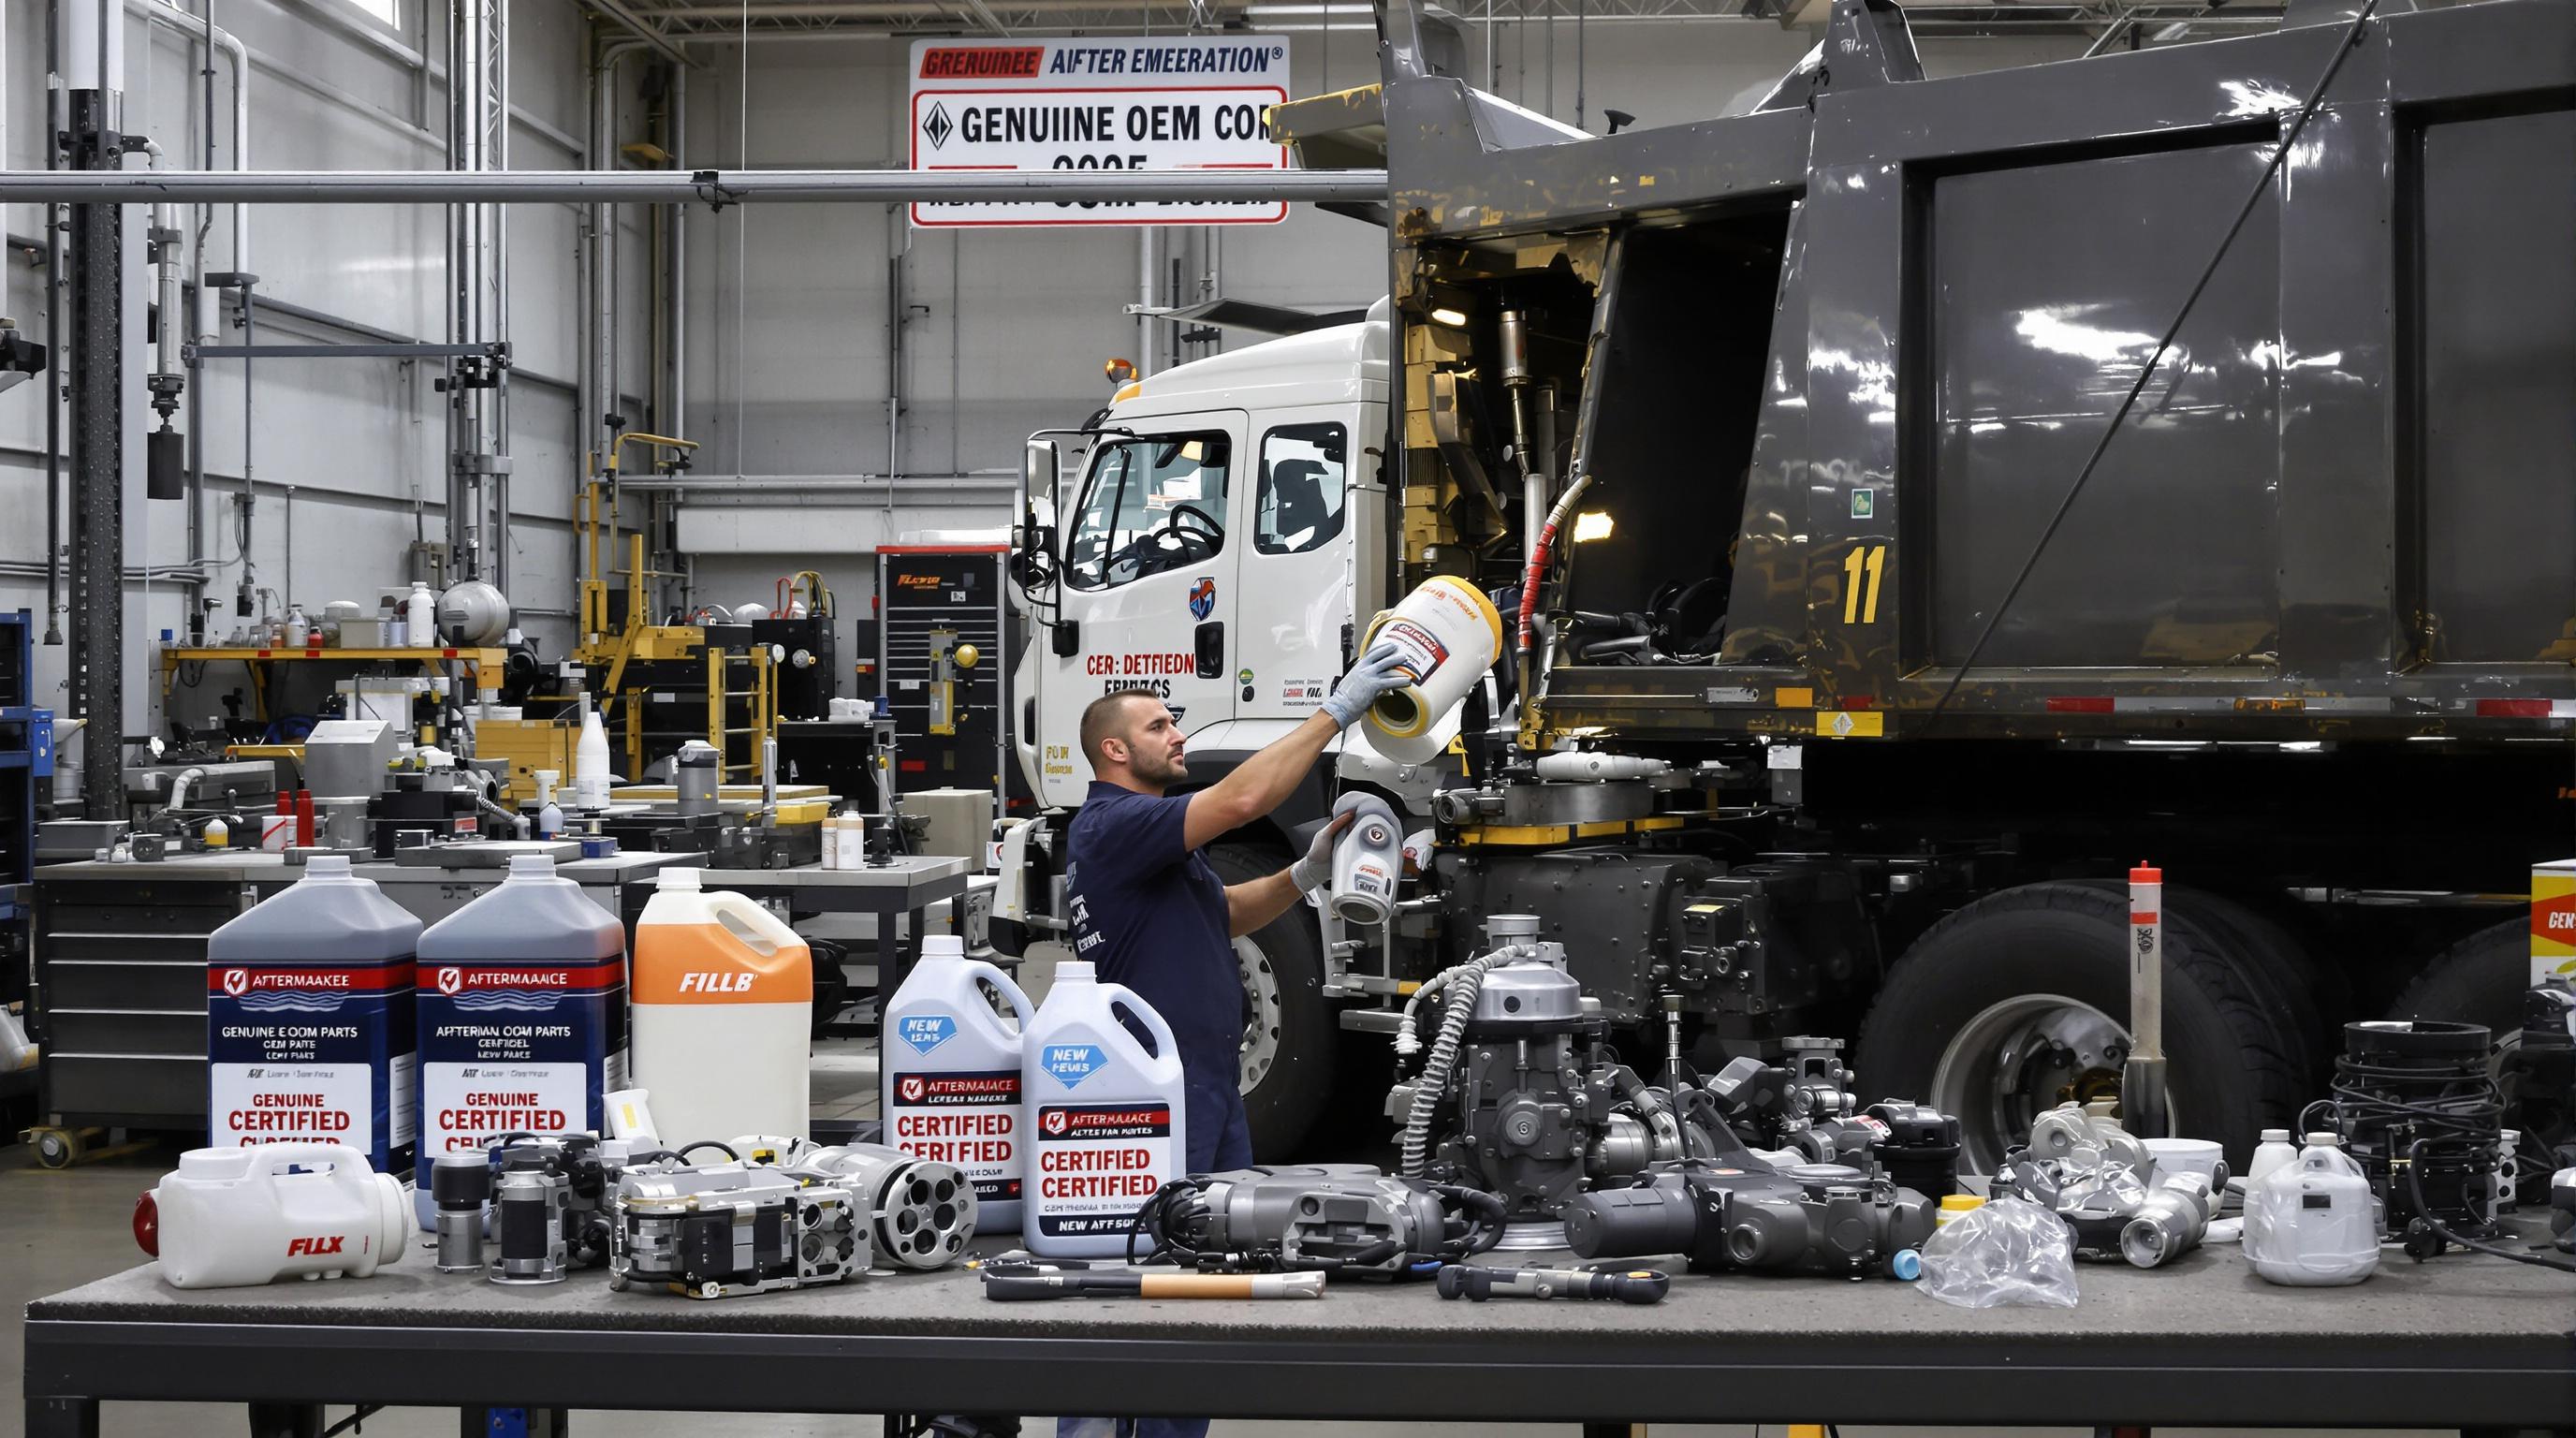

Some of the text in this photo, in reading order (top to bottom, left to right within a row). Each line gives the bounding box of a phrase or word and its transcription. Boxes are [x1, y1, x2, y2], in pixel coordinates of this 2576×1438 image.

[961, 106, 1115, 142] GENUIINE
[1126, 105, 1200, 141] OEM
[1844, 545, 1886, 624] 11
[222, 1026, 275, 1038] GENUINE
[321, 1026, 359, 1038] PARTS
[535, 1026, 571, 1037] PARTS
[907, 1019, 943, 1033] NEW
[1052, 1048, 1090, 1062] NEW
[253, 1093, 325, 1108] GENUINE
[465, 1093, 538, 1106] GENUINE
[228, 1110, 350, 1132] CERTIFIED
[439, 1108, 566, 1131] CERTIFIED
[898, 1114, 1013, 1137] CERTIFIED
[1041, 1149, 1150, 1172] CERTIFIED
[1042, 1175, 1158, 1198] CERTIFIED
[1059, 1220, 1088, 1232] NEW
